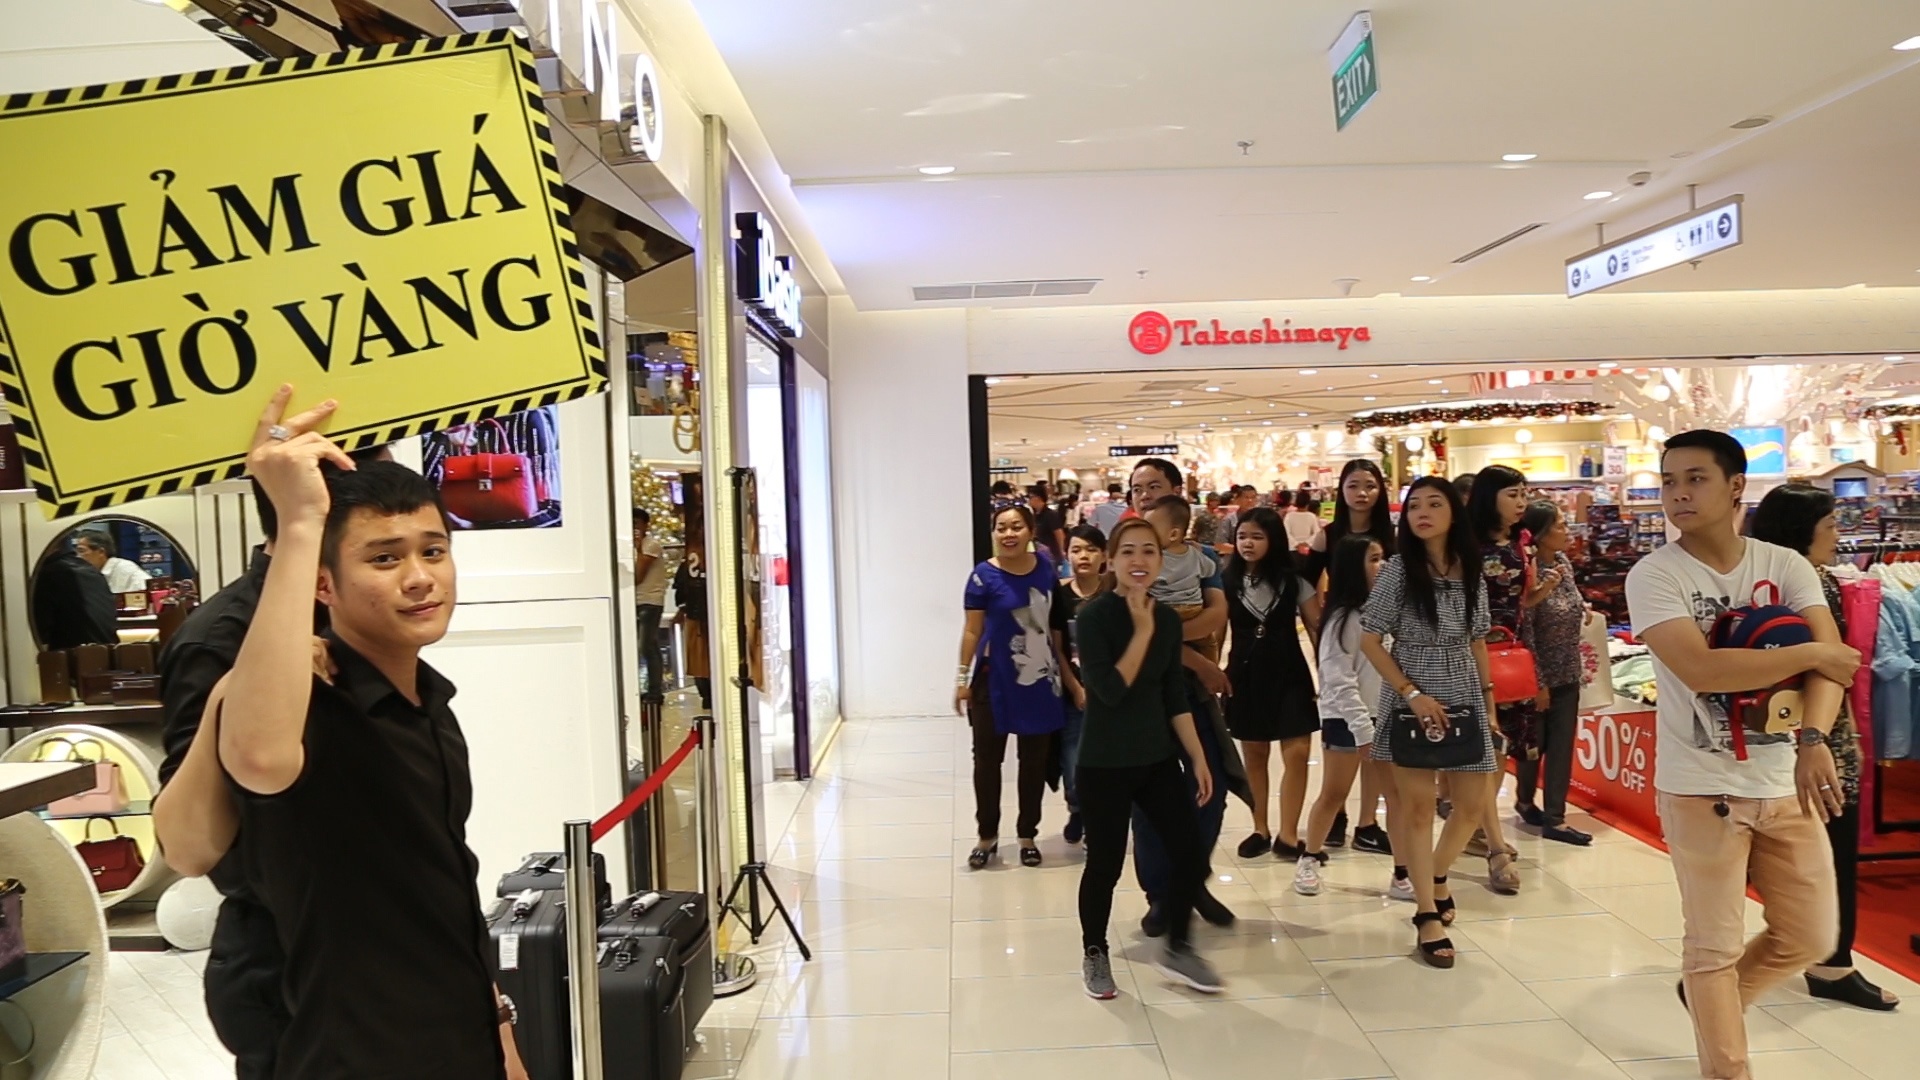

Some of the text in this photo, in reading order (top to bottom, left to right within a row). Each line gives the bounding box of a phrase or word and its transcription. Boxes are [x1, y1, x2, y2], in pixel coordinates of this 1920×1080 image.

[1336, 55, 1364, 118] EXIT
[8, 113, 527, 296] GIẢM GIÁ
[52, 254, 553, 421] GIỜ VÀNG
[1173, 318, 1371, 350] Takashimaya
[1576, 715, 1646, 780] 50%
[1620, 767, 1647, 793] OFF
